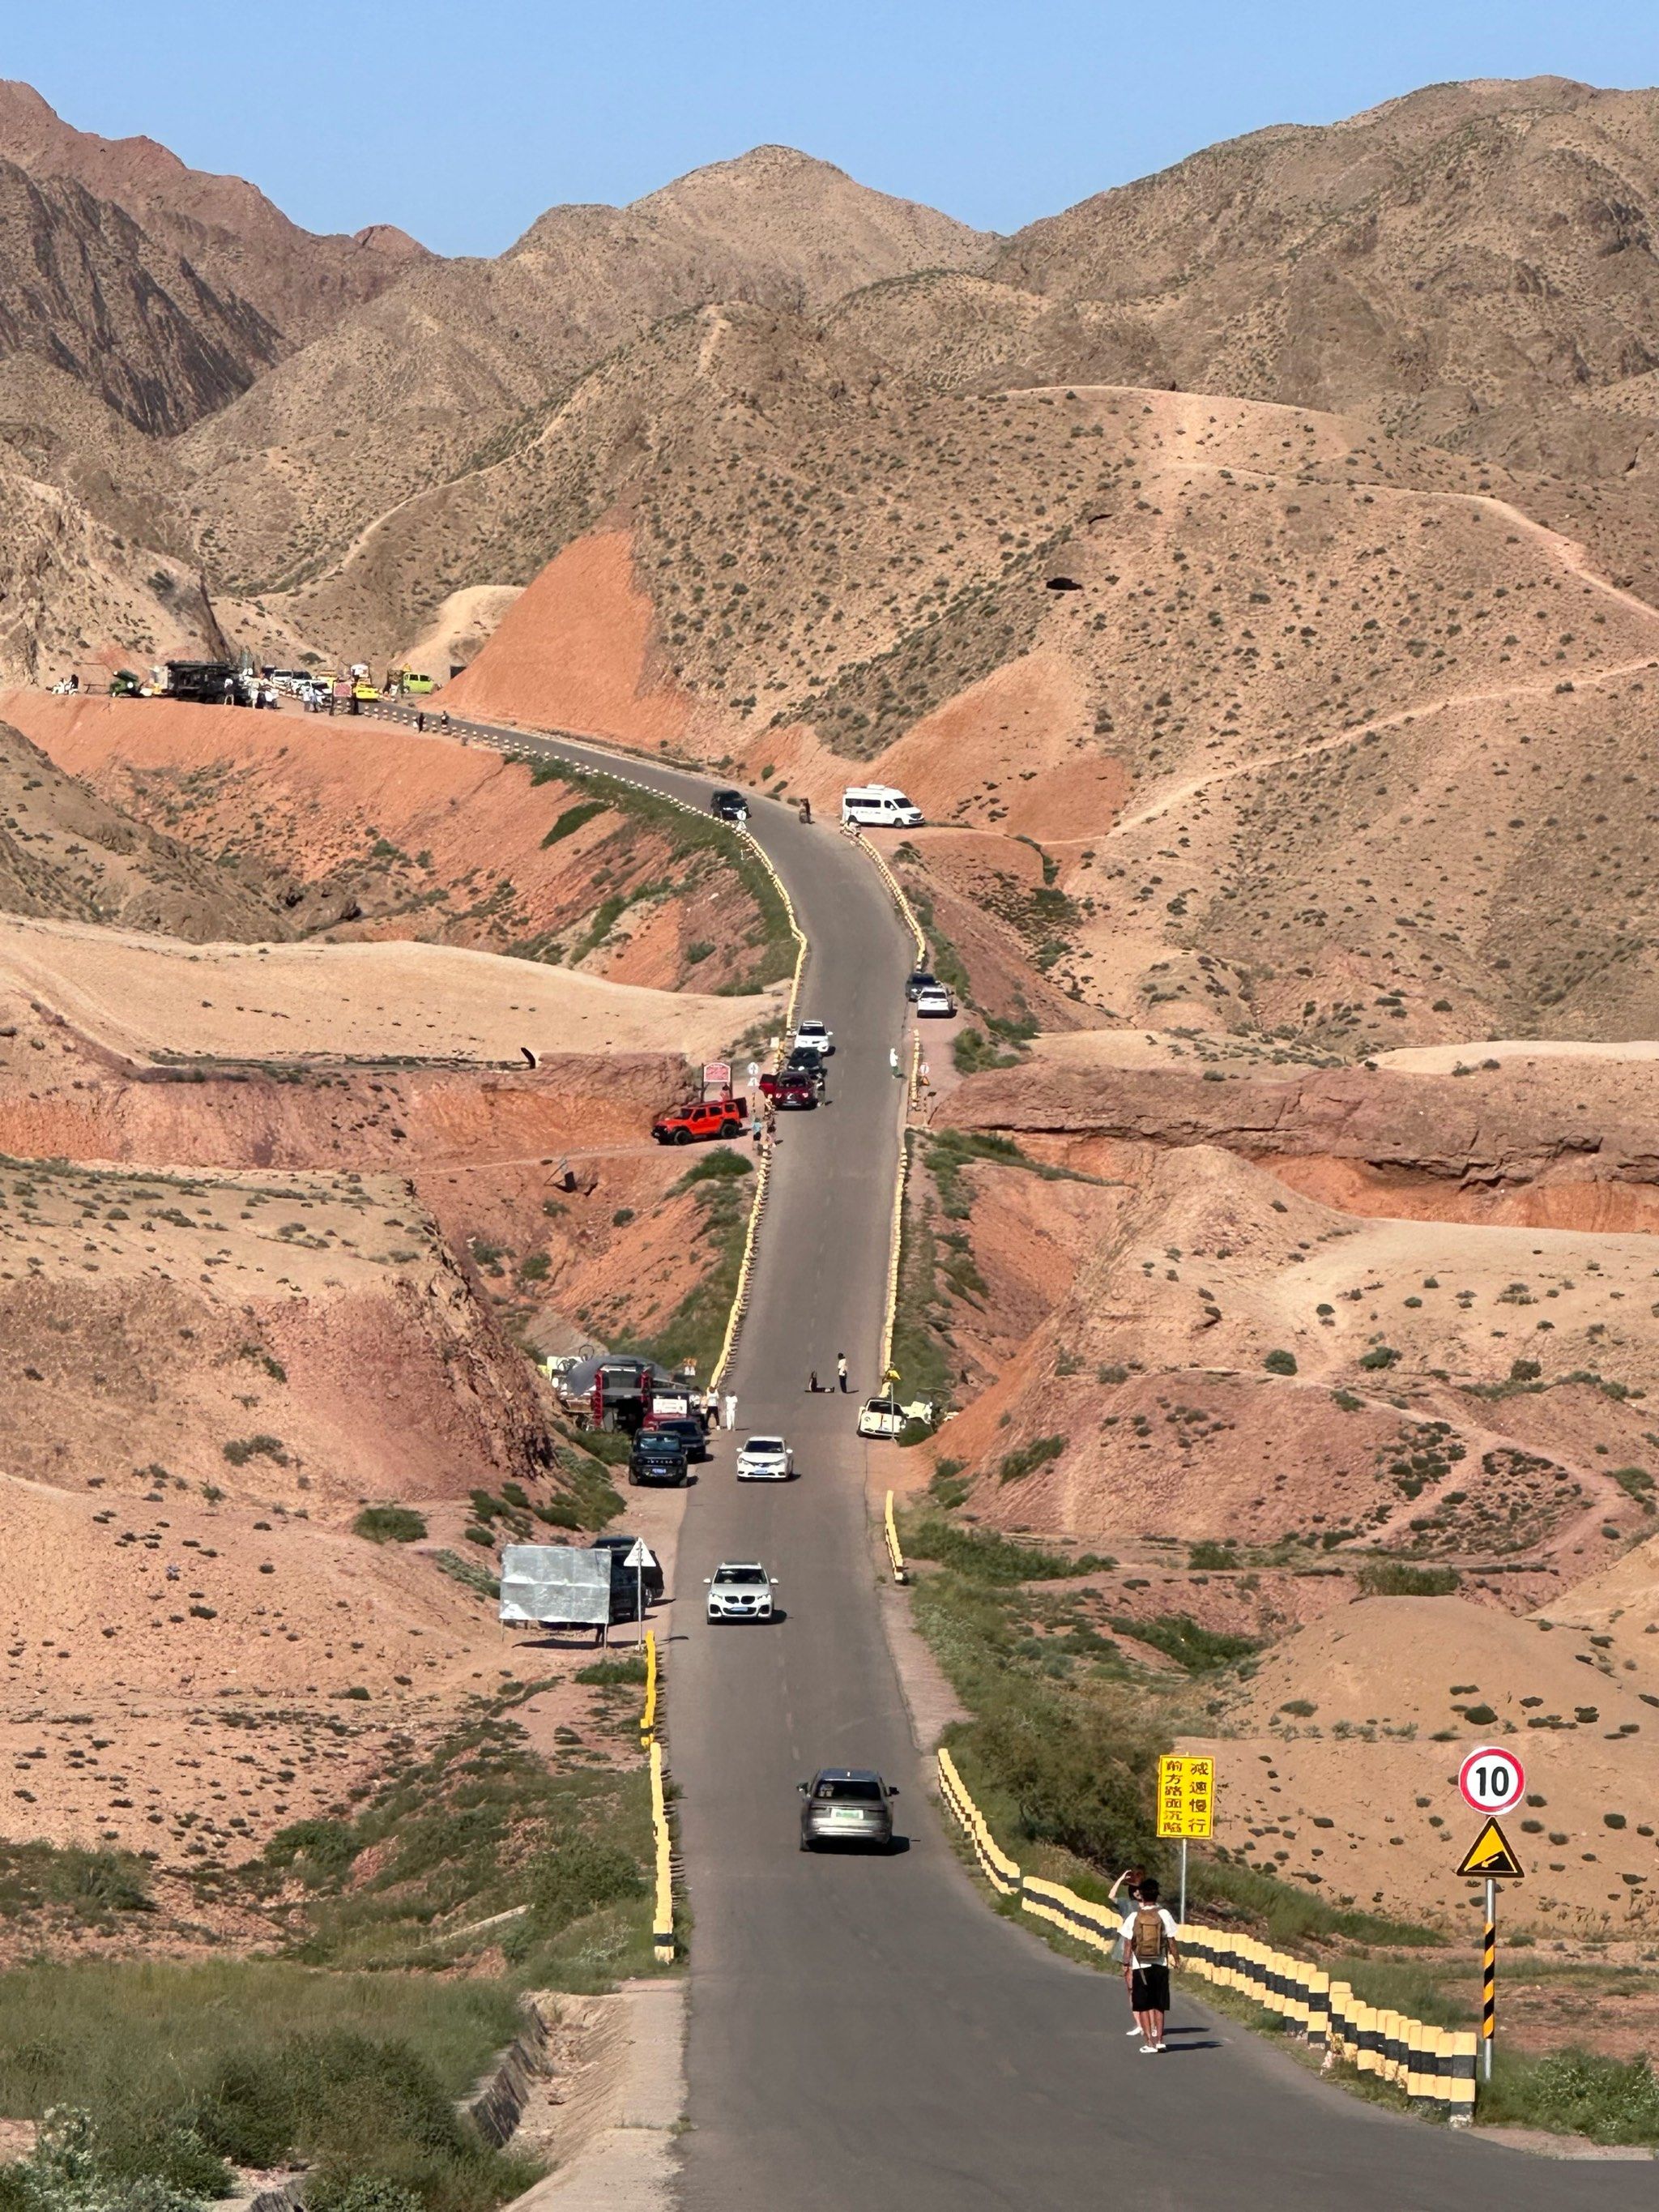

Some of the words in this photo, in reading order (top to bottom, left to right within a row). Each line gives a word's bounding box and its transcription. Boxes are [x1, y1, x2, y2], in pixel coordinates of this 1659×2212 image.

[1188, 1761, 1209, 1833] 减速慢行
[1476, 1766, 1509, 1796] 10
